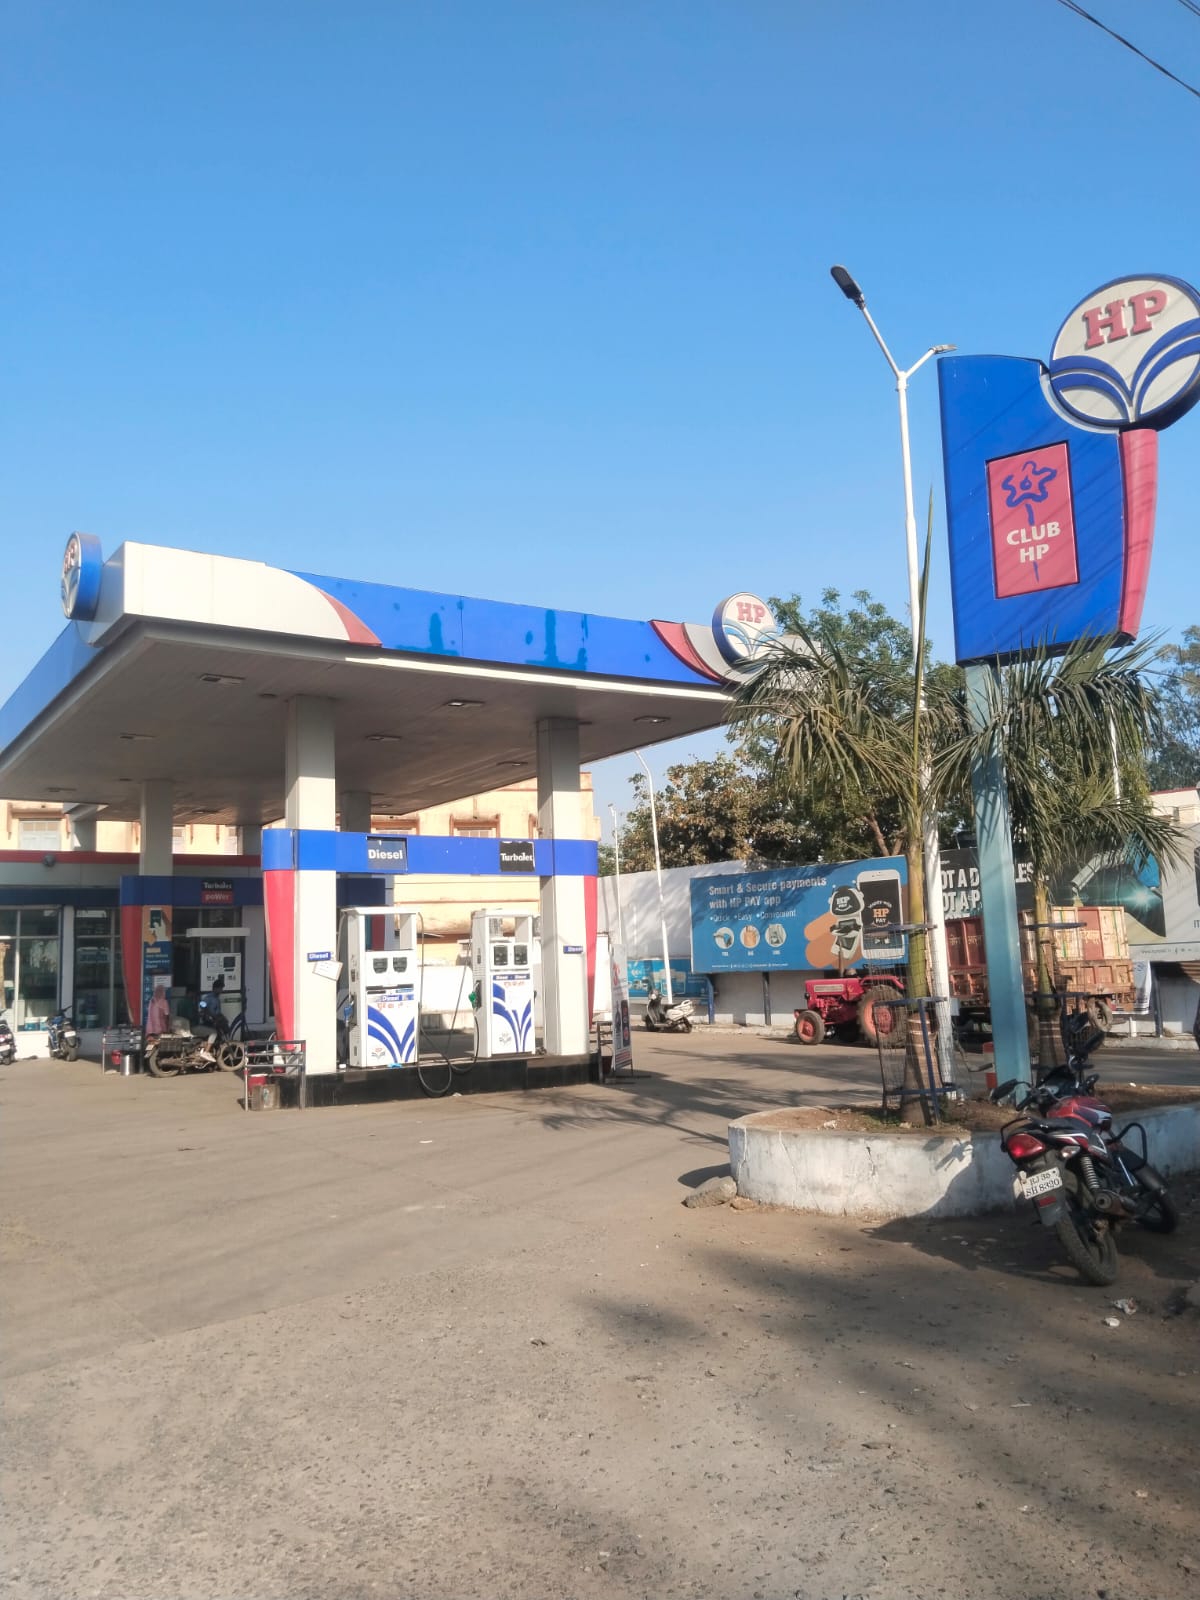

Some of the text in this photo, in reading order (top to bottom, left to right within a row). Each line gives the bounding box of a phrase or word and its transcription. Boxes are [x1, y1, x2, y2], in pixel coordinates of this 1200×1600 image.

[1083, 289, 1167, 349] HP
[1006, 521, 1061, 545] CLUB
[1019, 543, 1049, 563] HP
[736, 602, 766, 623] HP
[368, 849, 403, 860] Diesel
[708, 875, 828, 896] Smart & Secure payments
[709, 895, 781, 909] with HP PAY app
[836, 896, 850, 905] HP
[873, 908, 890, 918] HP
